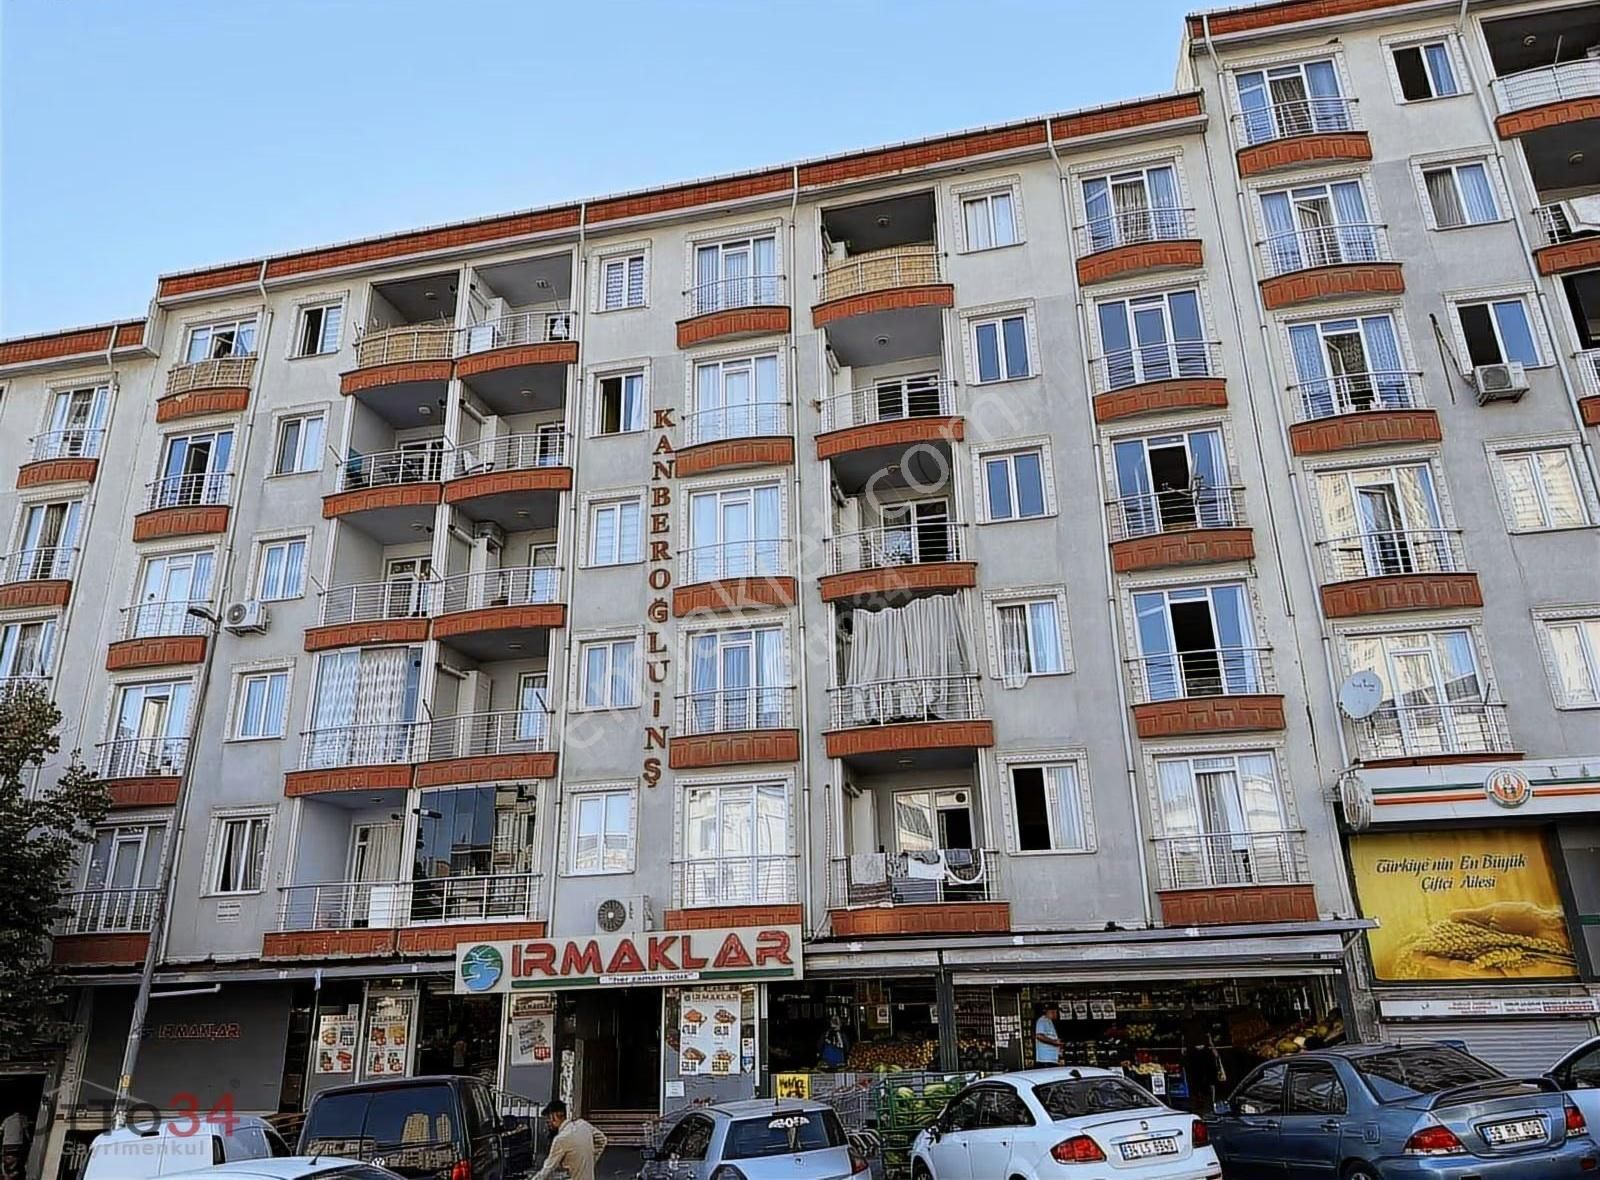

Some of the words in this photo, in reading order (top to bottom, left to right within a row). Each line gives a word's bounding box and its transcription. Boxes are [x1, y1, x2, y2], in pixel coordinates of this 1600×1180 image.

[1460, 855, 1478, 870] En
[1482, 853, 1527, 874] Büyük
[1421, 876, 1454, 892] Çiftçi
[1460, 874, 1497, 889] Ailesi
[511, 930, 794, 978] IRMAKLAR
